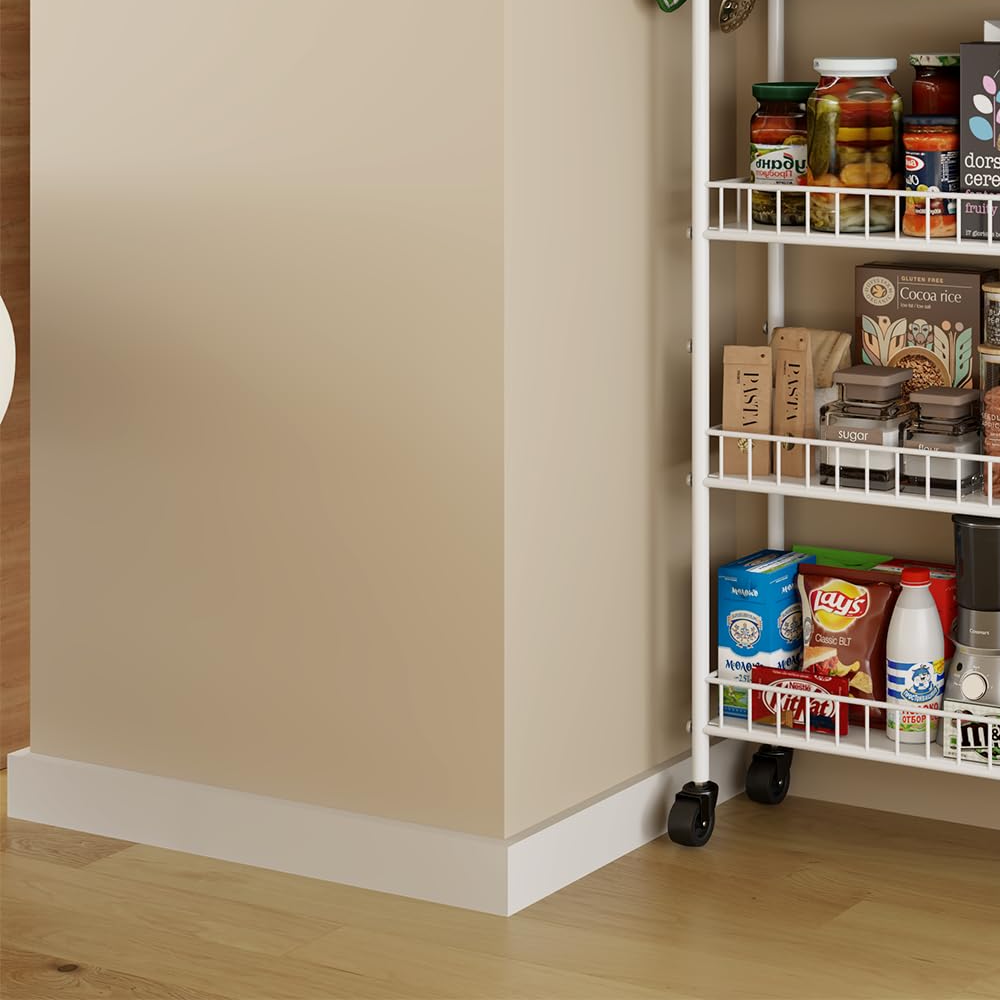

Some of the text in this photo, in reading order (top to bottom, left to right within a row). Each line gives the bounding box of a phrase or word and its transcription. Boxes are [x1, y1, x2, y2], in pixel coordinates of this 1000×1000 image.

[965, 202, 998, 216] fruiy
[900, 287, 962, 303] Cocoa rice
[742, 372, 759, 426] PASTA
[787, 363, 801, 420] PASTA
[838, 430, 868, 442] sugar
[814, 589, 866, 616] Lay's
[815, 633, 852, 647] Classic BLT
